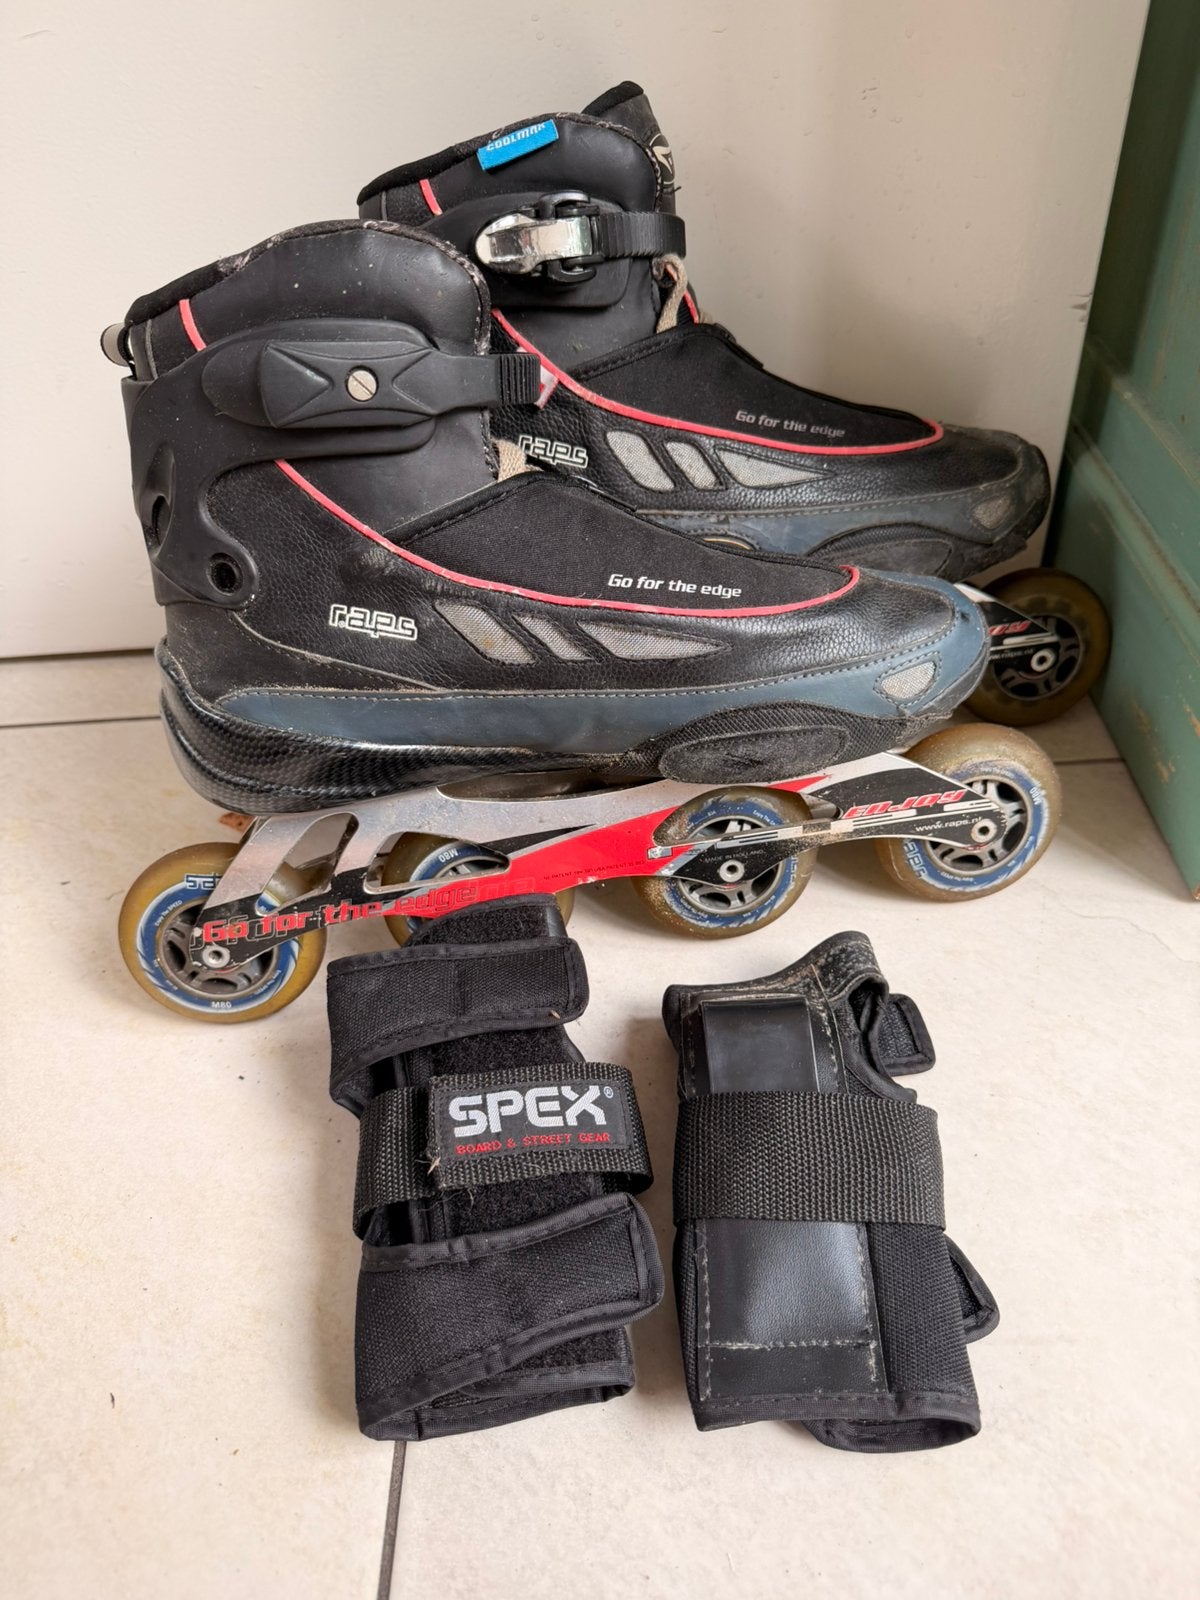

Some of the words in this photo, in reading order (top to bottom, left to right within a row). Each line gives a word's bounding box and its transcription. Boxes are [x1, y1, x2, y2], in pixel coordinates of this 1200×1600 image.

[735, 410, 756, 423] Go
[758, 415, 780, 428] for
[783, 420, 807, 432] the
[810, 425, 846, 438] edge
[519, 434, 588, 468] raps
[608, 573, 633, 588] Go
[636, 576, 664, 590] for
[668, 580, 697, 593] the
[700, 584, 742, 599] edge
[329, 604, 418, 641] raps
[438, 847, 459, 864] M80
[202, 920, 248, 943] Go
[261, 910, 313, 932] for
[323, 902, 383, 924] the
[393, 885, 478, 912] edge
[456, 1139, 501, 1155] BOARD
[507, 1137, 516, 1149] &
[523, 1133, 572, 1147] STREET
[578, 1132, 611, 1144] GEAR
